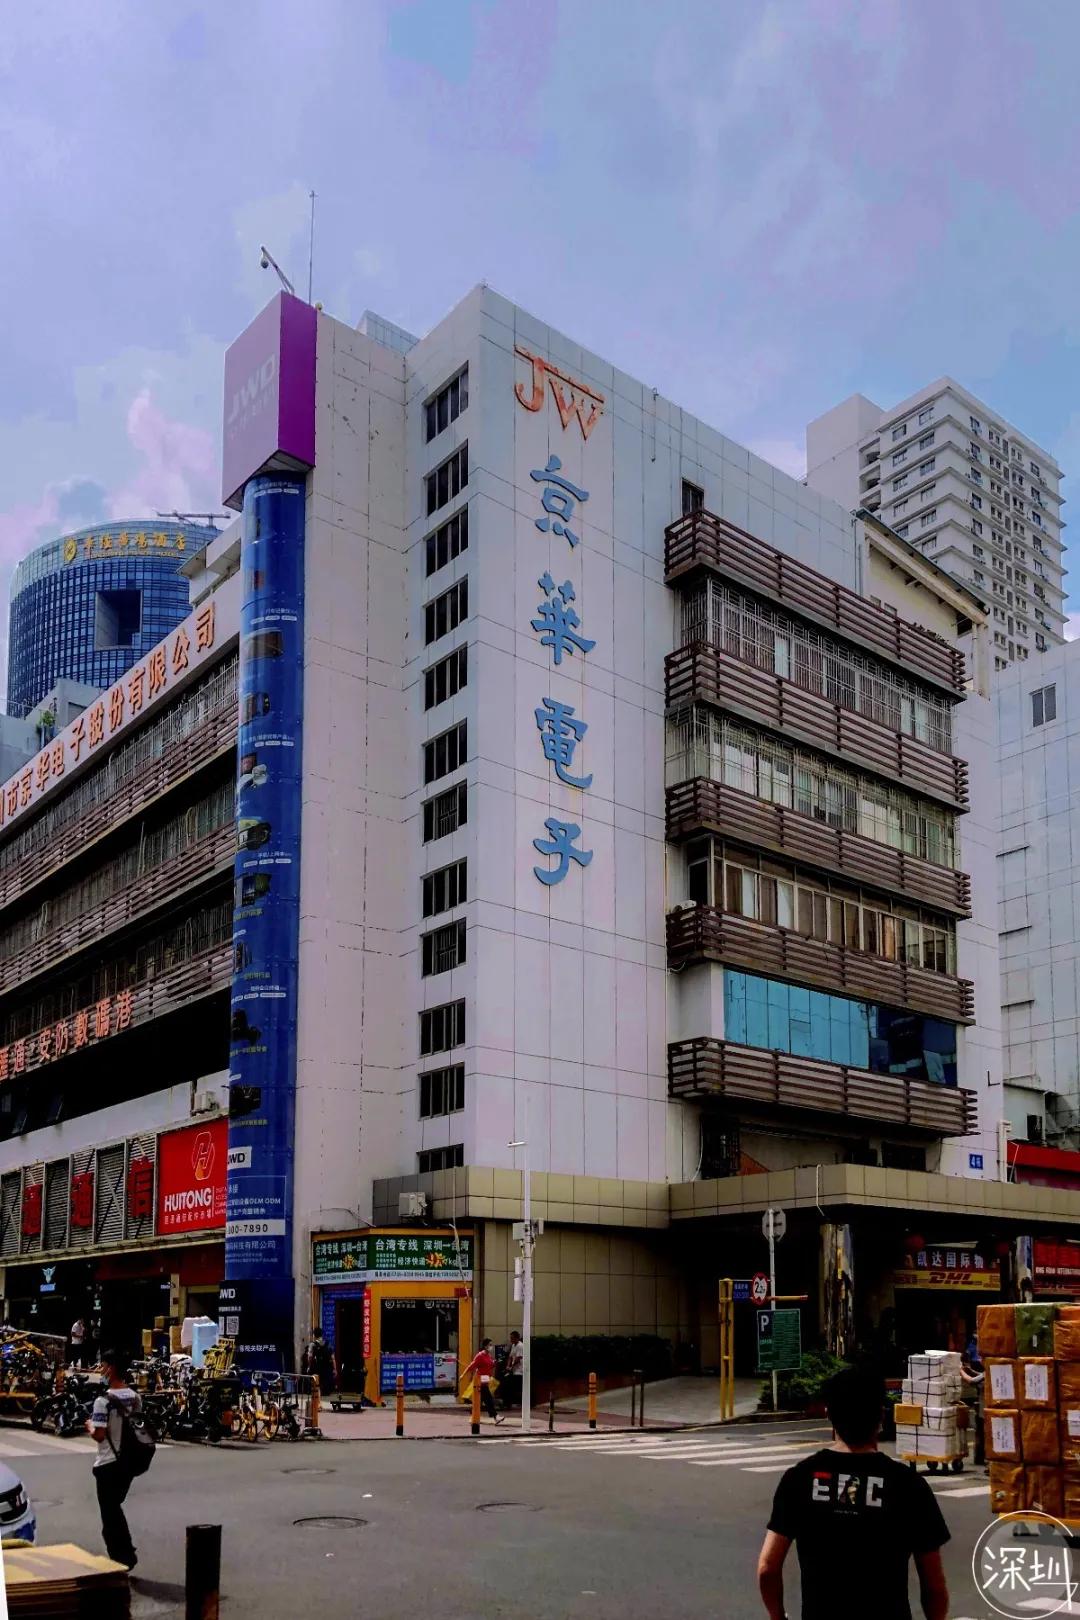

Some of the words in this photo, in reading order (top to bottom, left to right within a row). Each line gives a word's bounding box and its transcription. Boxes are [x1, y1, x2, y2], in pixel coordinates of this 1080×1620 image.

[0, 601, 216, 824] 市京华电子股份有限公司
[164, 1187, 212, 1213] HUITONG
[376, 1239, 419, 1252] 台湾专线
[929, 1271, 974, 1285] DHL
[760, 1314, 770, 1332] P
